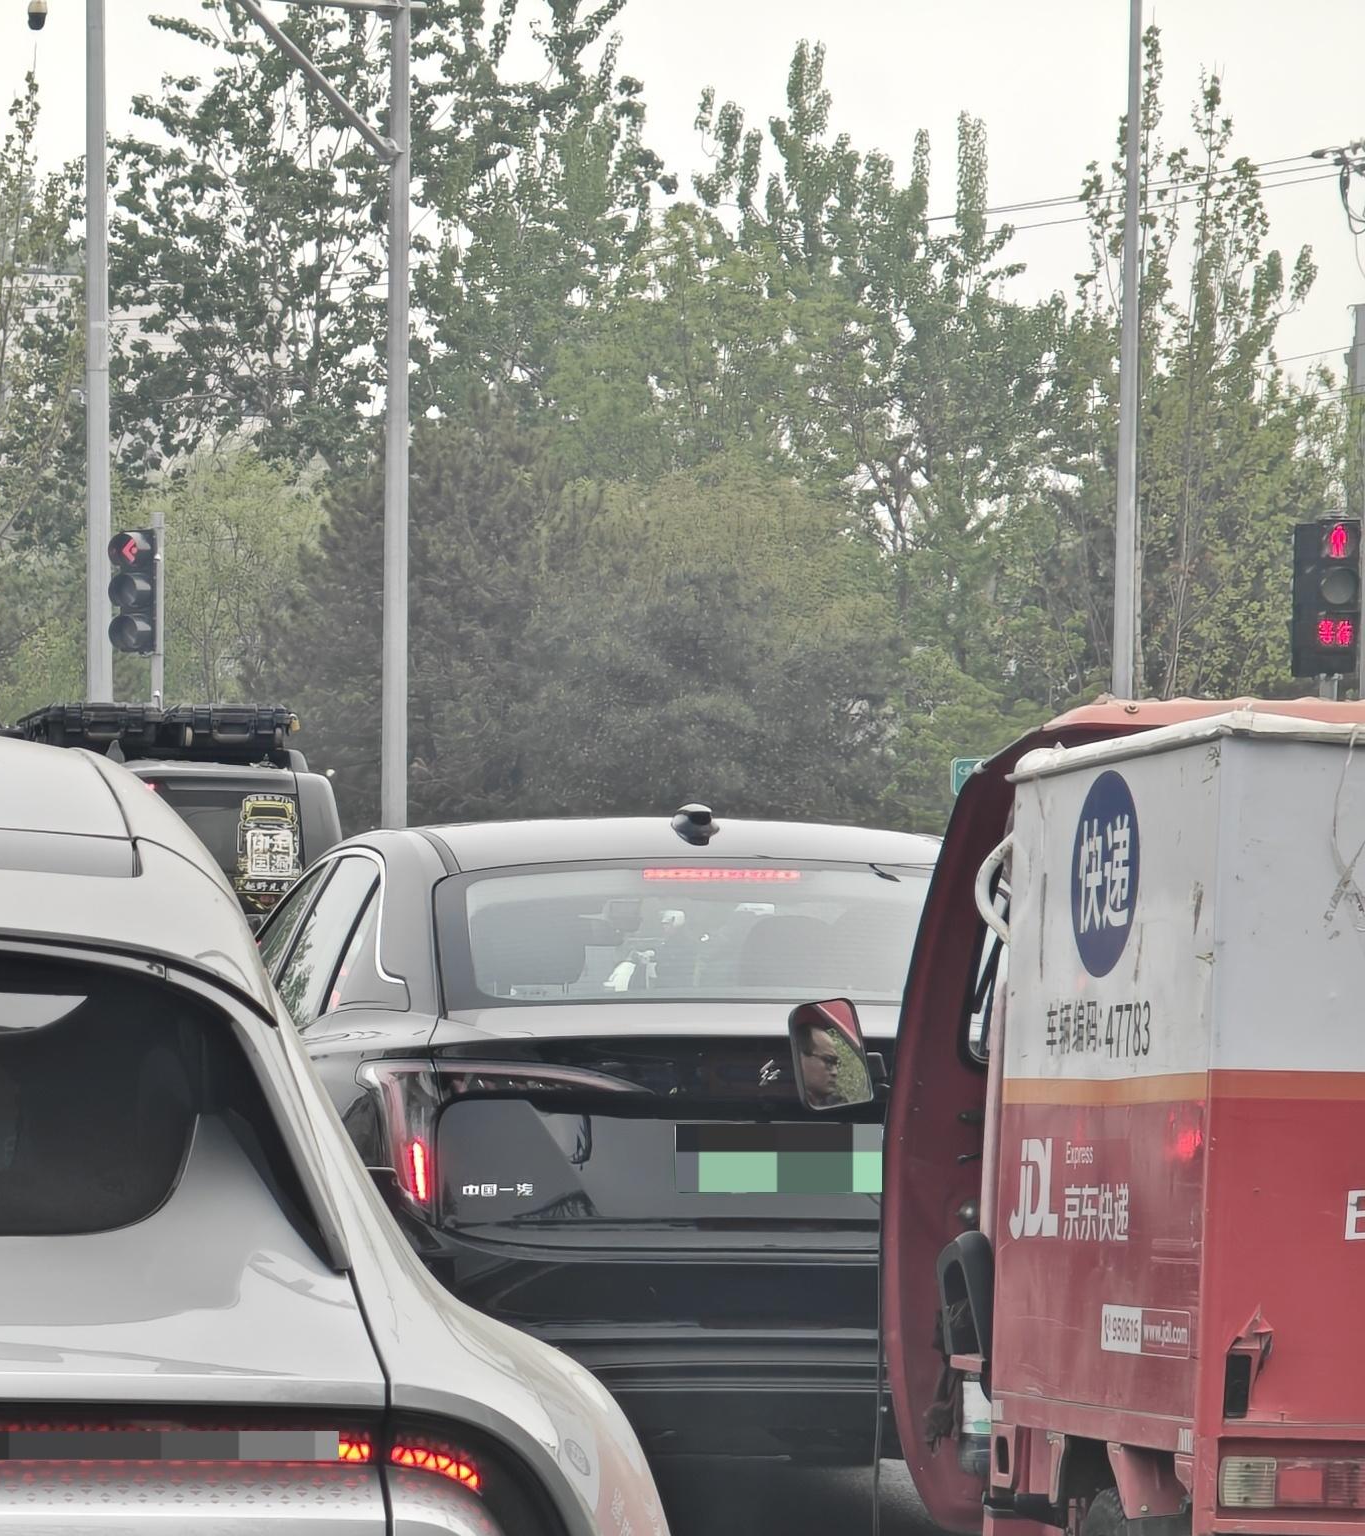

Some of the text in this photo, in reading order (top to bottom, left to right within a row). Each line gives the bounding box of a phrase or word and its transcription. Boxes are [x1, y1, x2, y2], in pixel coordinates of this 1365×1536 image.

[1318, 619, 1352, 647] 等待
[1079, 814, 1131, 933] 快递
[1066, 1141, 1094, 1170] Express
[462, 1183, 534, 1197] 中国一汽
[1062, 1183, 1129, 1241] 京东快递
